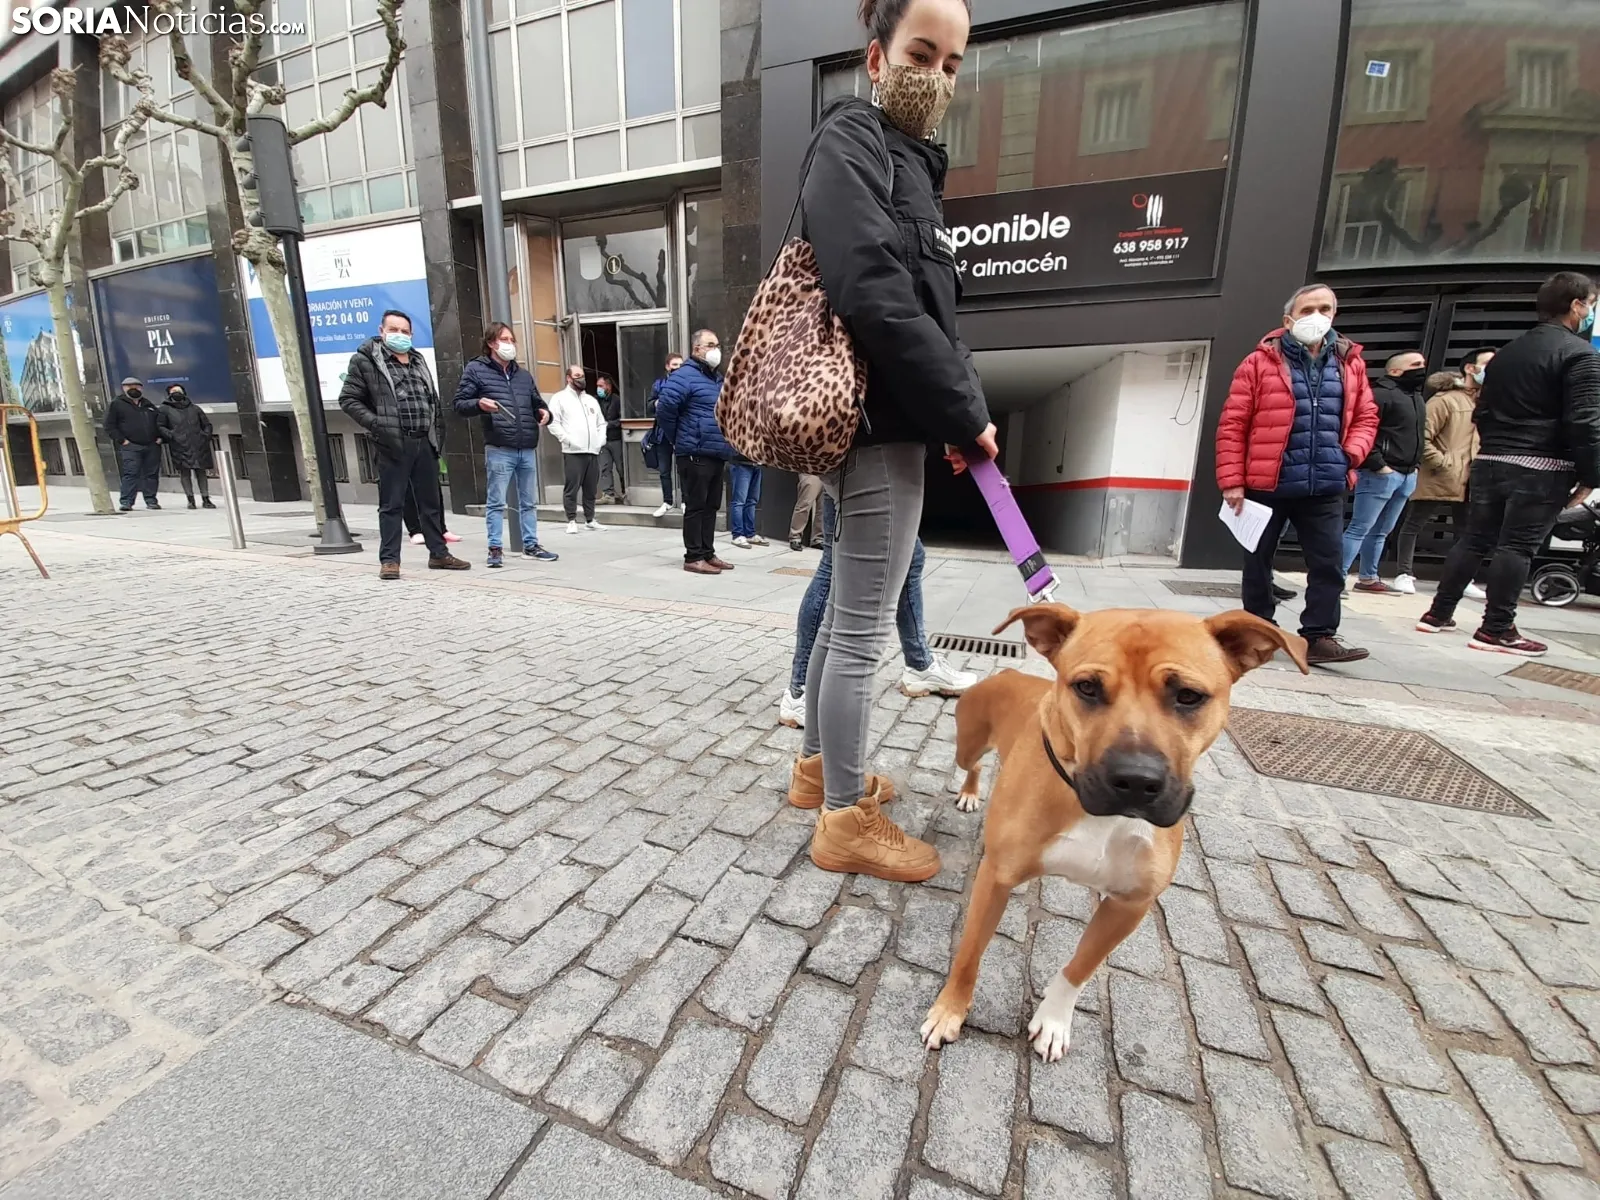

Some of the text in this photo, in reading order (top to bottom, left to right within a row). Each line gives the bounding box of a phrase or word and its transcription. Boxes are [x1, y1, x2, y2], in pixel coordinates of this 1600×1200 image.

[1113, 237, 1189, 254] 638 958 917
[972, 252, 1068, 277] almacén
[342, 300, 349, 309] Y
[349, 297, 374, 309] VENTA
[144, 314, 170, 323] EDIFICIO
[325, 314, 338, 326] 22
[340, 312, 353, 324] 04
[356, 311, 369, 323] 00
[147, 329, 174, 348] PLA
[153, 347, 173, 365] ZA
